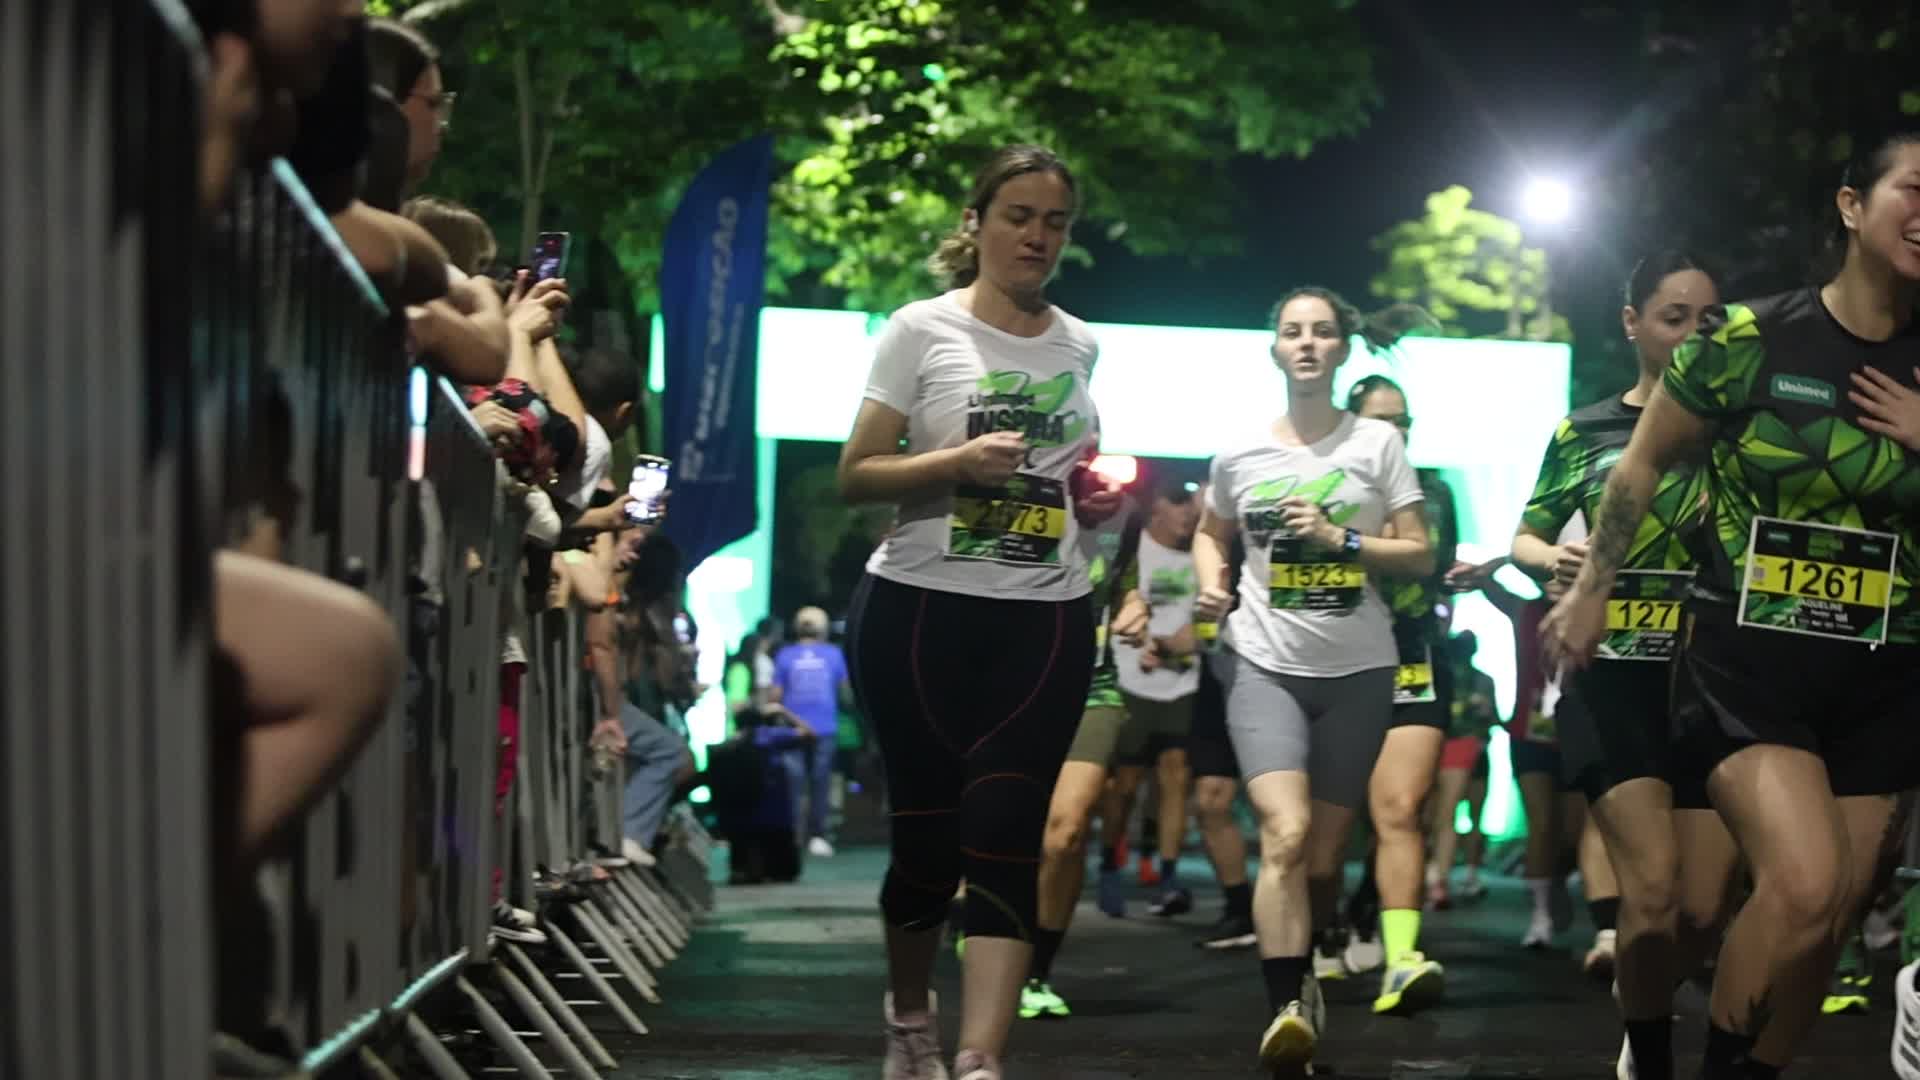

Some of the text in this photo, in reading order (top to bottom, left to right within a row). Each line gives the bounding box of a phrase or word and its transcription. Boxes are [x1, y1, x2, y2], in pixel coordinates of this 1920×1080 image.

[1778, 380, 1830, 400] Unimed
[1284, 566, 1347, 587] 1523
[1779, 559, 1864, 602] 1261
[1618, 601, 1682, 628] 127
